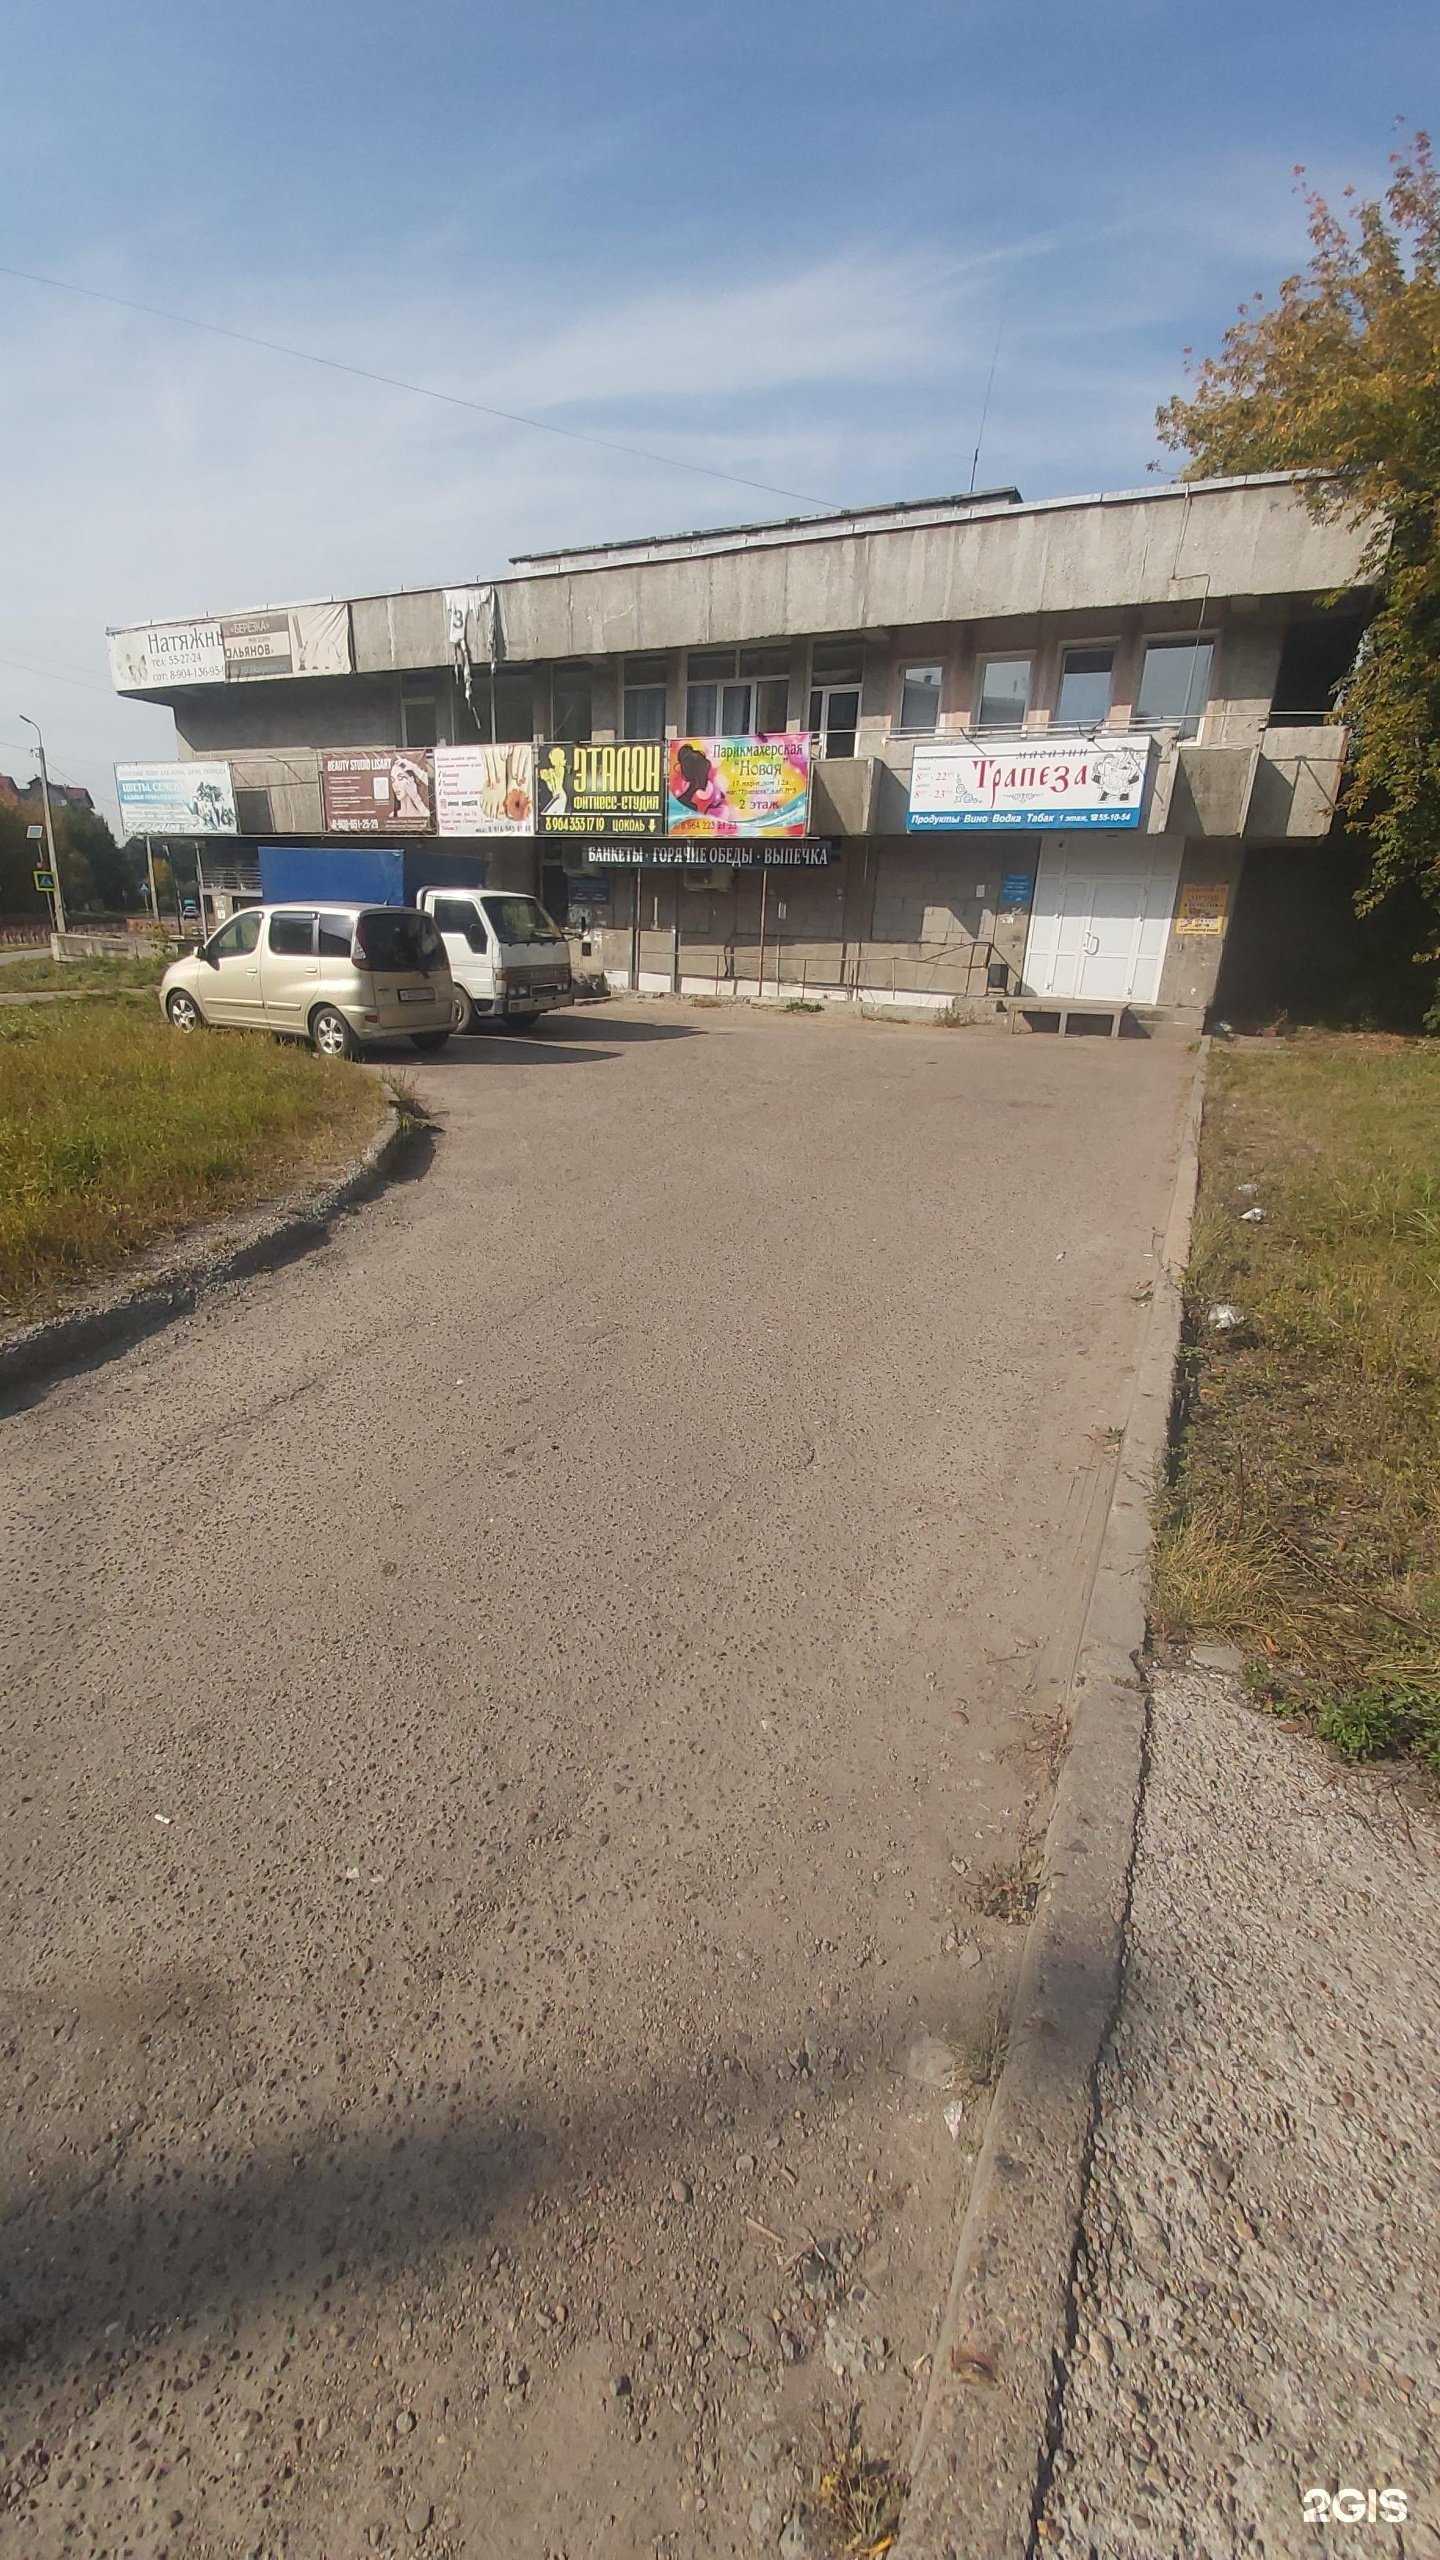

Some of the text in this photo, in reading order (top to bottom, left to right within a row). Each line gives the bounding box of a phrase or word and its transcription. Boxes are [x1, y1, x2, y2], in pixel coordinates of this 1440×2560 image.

[713, 743, 803, 761] Парикмахерская
[573, 746, 660, 792] ЭТАЛОН
[971, 760, 1088, 808] Трапеза
[739, 800, 780, 810] 2 этаж
[612, 819, 646, 832] ЦОКОЛЬ
[911, 814, 960, 825] Продукты
[963, 814, 988, 823] Вино
[992, 813, 1021, 823] Водка
[1027, 812, 1055, 823] Табак
[588, 846, 828, 867] БАНКЕТЫ ГОРЯЧИЕ ОБЕДЫ ВЫПЕЧКА
